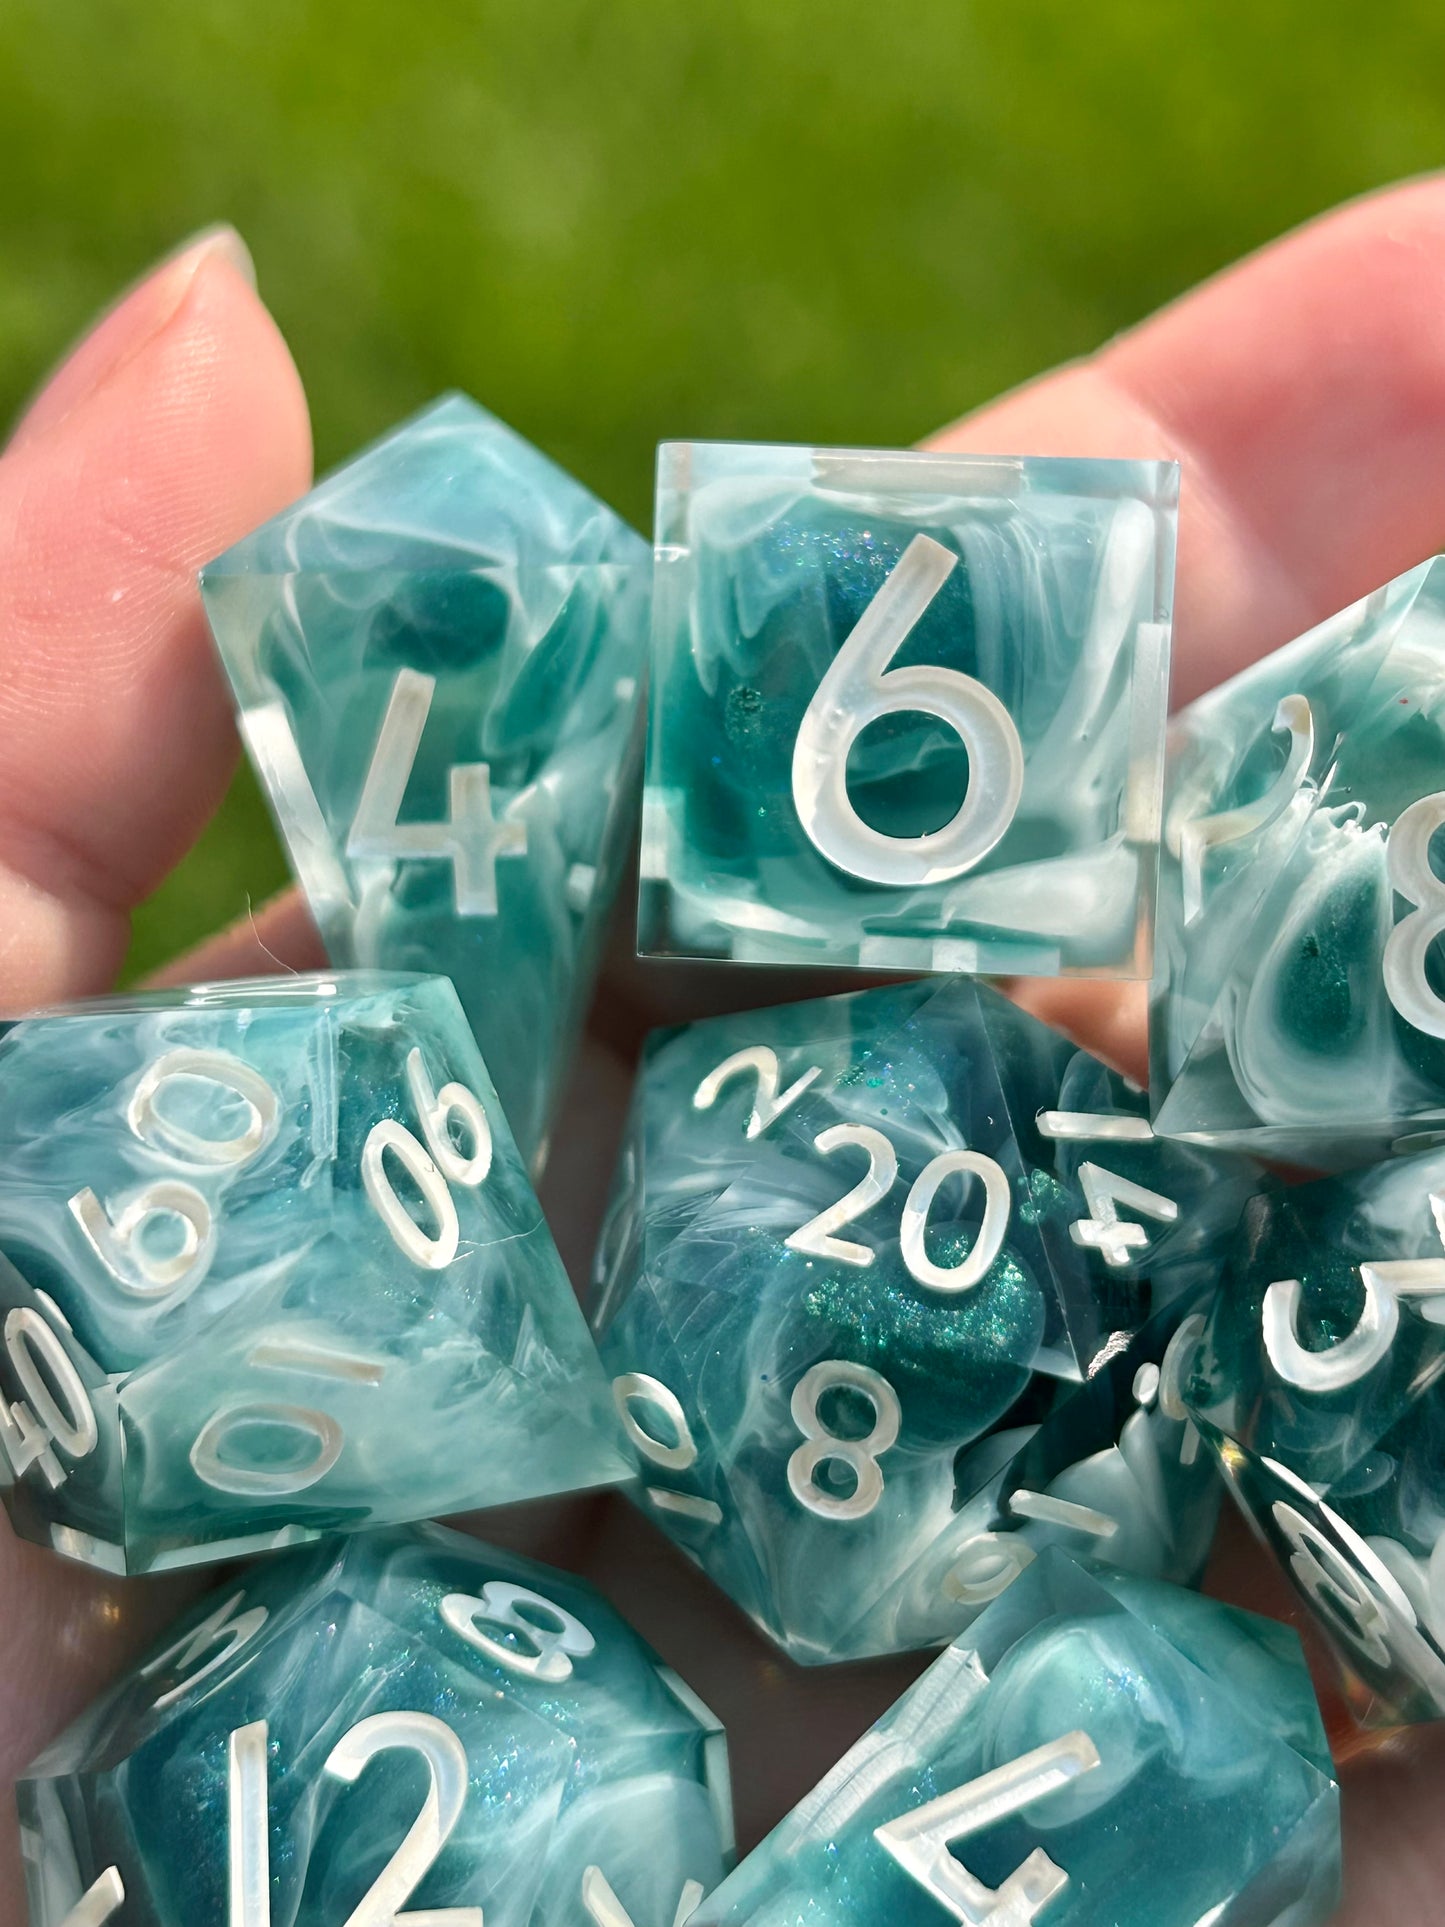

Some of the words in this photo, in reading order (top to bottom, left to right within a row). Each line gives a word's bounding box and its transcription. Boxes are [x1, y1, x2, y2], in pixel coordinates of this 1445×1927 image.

[347, 668, 528, 915] 4
[791, 533, 1024, 886] 6
[693, 1045, 822, 1139] 2
[785, 1123, 1011, 1292] 20
[787, 1359, 901, 1520] 8
[439, 1580, 596, 1683] 8
[229, 1711, 483, 1927] 12
